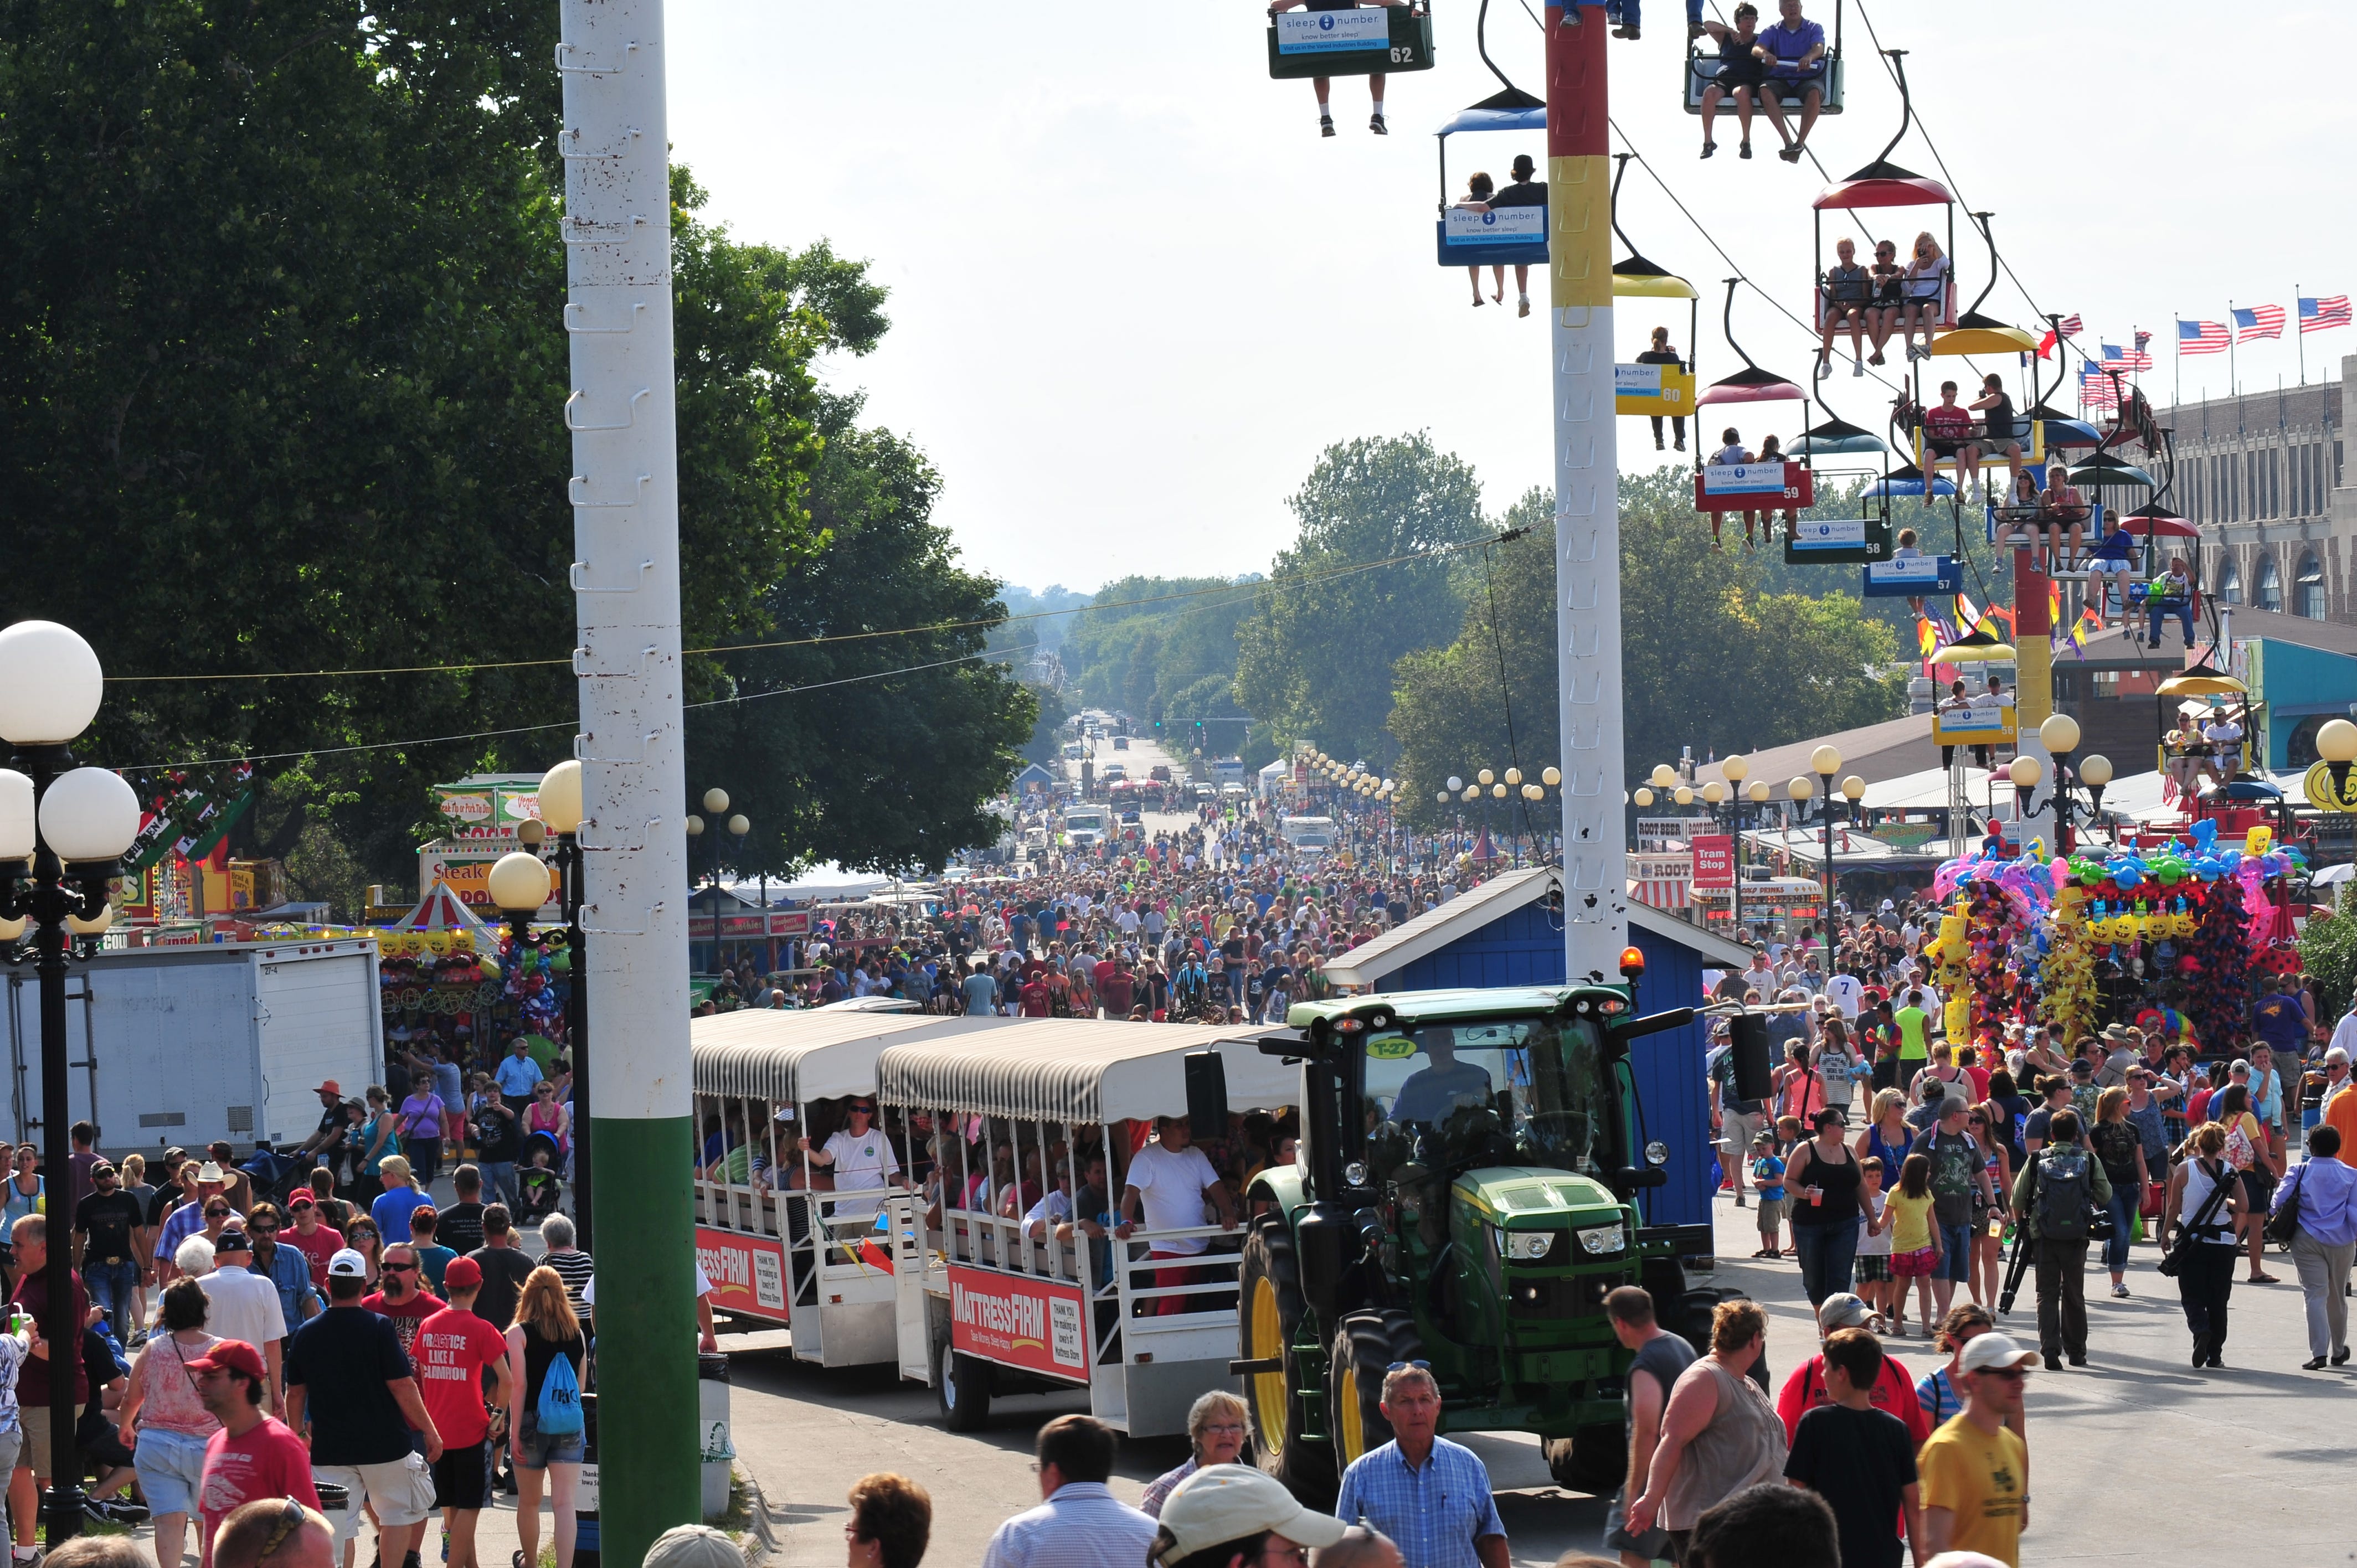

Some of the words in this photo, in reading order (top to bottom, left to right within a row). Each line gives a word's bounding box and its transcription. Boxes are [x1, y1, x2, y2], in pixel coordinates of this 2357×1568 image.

[1286, 18, 1315, 29] sleep
[1337, 16, 1377, 25] number
[1390, 47, 1413, 63] 62
[1453, 214, 1479, 223] sleep
[1499, 212, 1535, 220] number
[1663, 388, 1680, 402] 60
[1710, 469, 1732, 477] sleep
[1784, 487, 1799, 499] 59
[1866, 543, 1880, 554] 58
[1938, 580, 1950, 589] 57
[2002, 726, 2014, 735] 56
[1639, 822, 1659, 835] ROOT
[1660, 823, 1681, 835] BEER
[1689, 822, 1703, 835] ROOT
[1704, 822, 1718, 834] BEER
[1699, 849, 1725, 858] Tram
[433, 862, 485, 880] Steak
[1654, 864, 1690, 877] ROOT
[1700, 860, 1726, 870] Stop
[231, 872, 244, 881] Brad
[722, 920, 762, 933] Smoothies
[784, 922, 805, 931] Smoothies
[103, 934, 128, 950] COLD
[265, 967, 277, 975] 27-4
[1840, 982, 1850, 995] 7
[1374, 1043, 1409, 1055] T-27
[696, 1246, 749, 1286] RESSFIRM
[757, 1255, 768, 1265] THANK
[762, 1268, 774, 1280] making
[761, 1280, 771, 1290] Iowa's
[771, 1282, 775, 1290] #1
[759, 1291, 772, 1302] Mattress
[772, 1293, 780, 1303] Store
[1054, 1303, 1066, 1315] THANK
[1059, 1319, 1072, 1333] making
[1072, 1323, 1077, 1332] us
[423, 1333, 466, 1350] PRACTICE
[990, 1333, 999, 1349] Sleep
[1058, 1333, 1069, 1344] Iowa's
[1069, 1335, 1074, 1345] #1
[429, 1349, 447, 1364] LIKE
[449, 1350, 454, 1365] A
[1055, 1347, 1069, 1358] Mattress
[1069, 1350, 1079, 1360] Store
